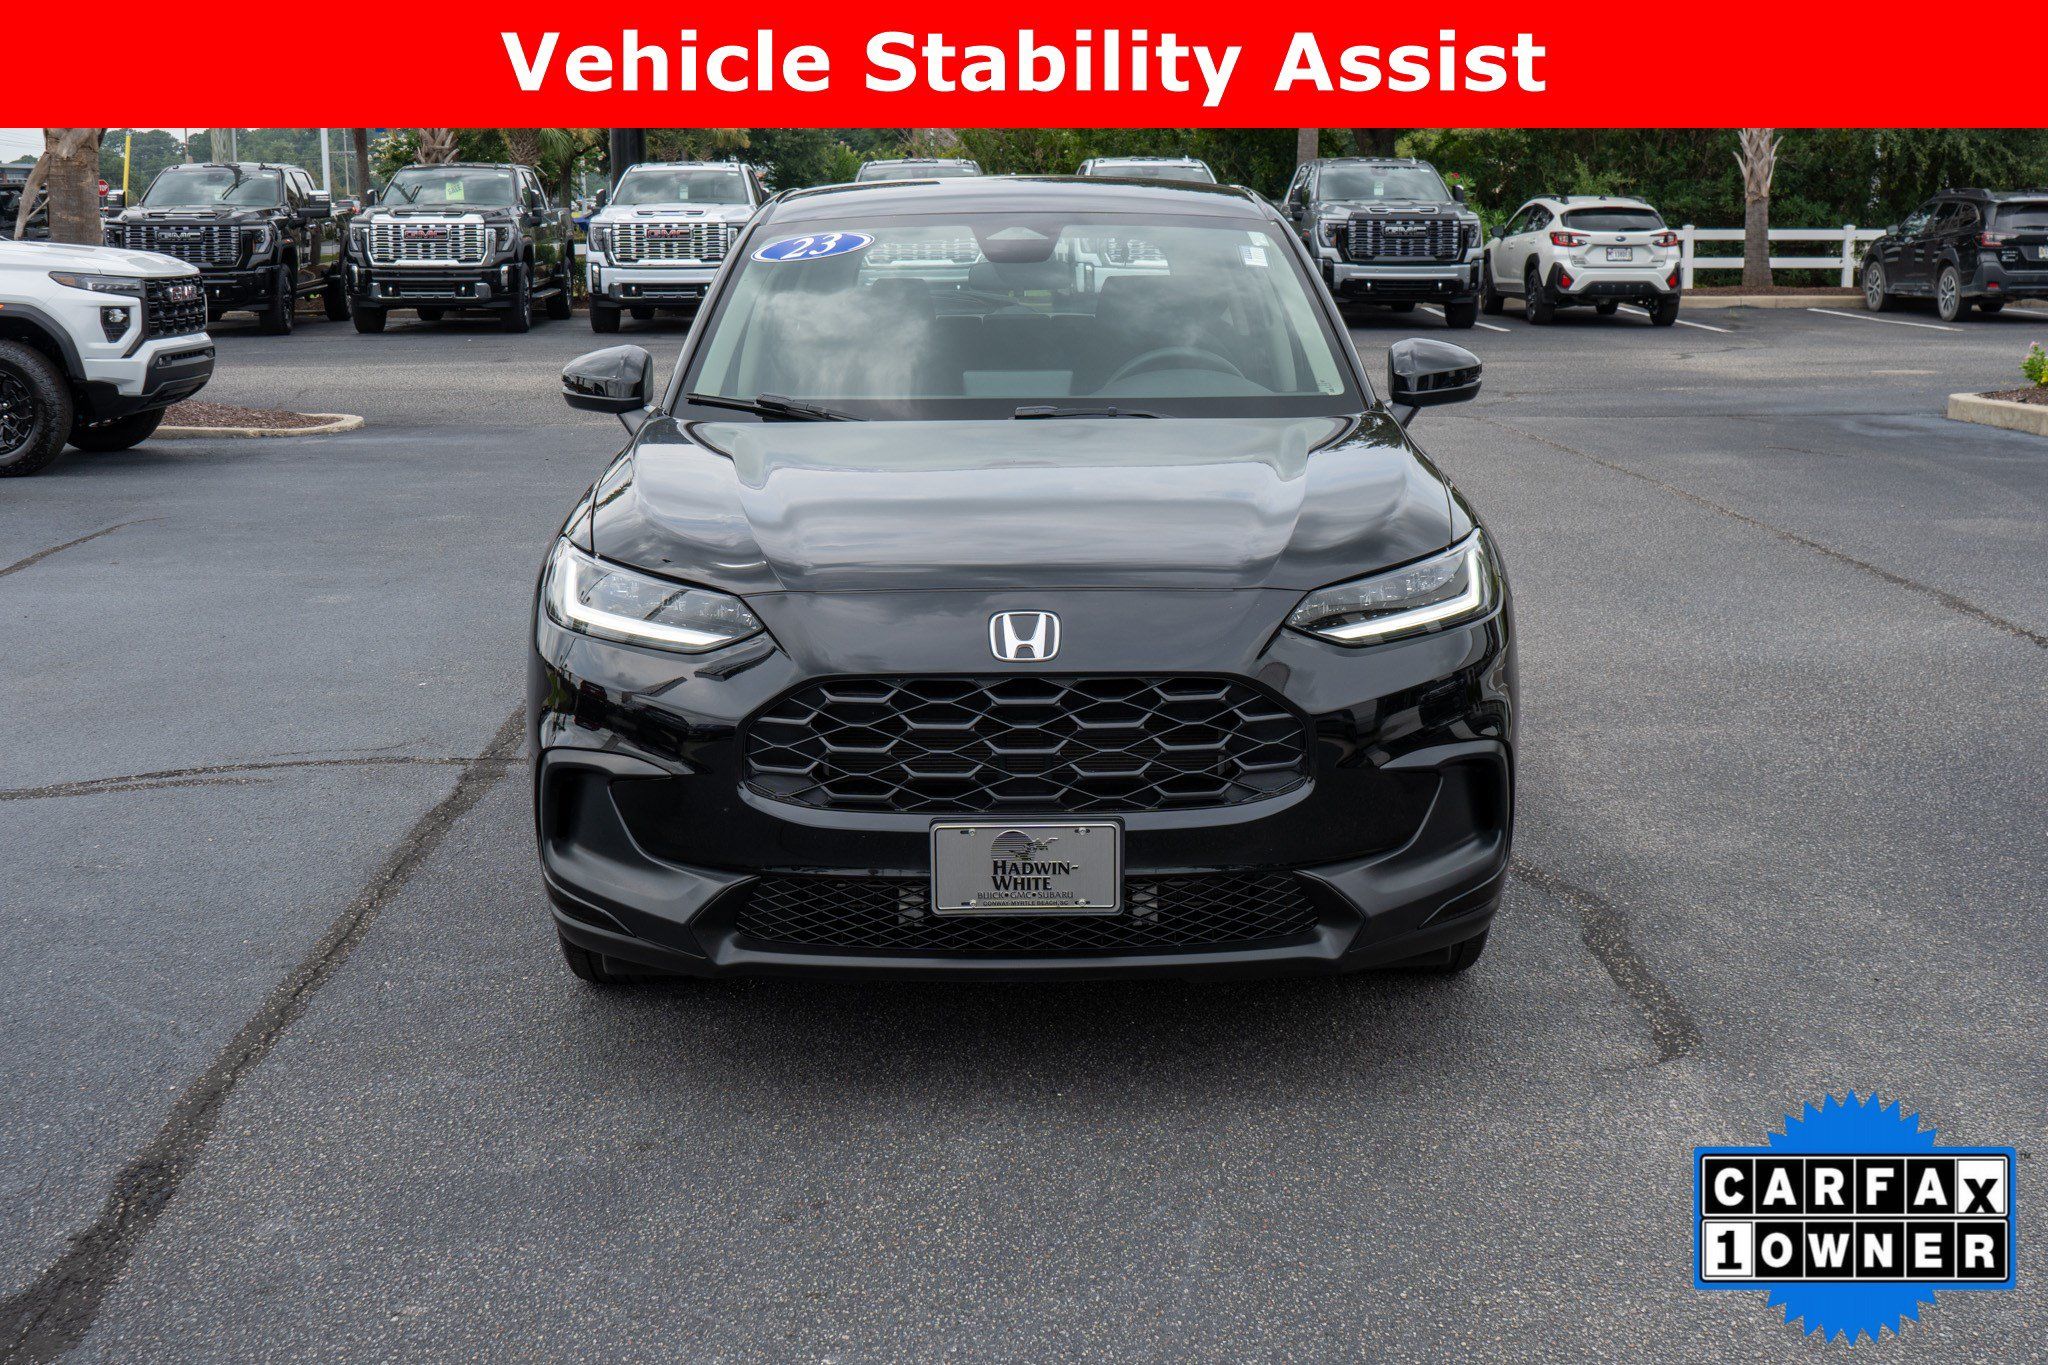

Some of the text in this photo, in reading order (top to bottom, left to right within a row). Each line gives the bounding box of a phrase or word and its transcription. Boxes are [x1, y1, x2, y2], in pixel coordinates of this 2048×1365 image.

[404, 230, 447, 239] GMC
[647, 229, 690, 238] GMC
[1385, 226, 1427, 236] GMC
[157, 232, 201, 241] GMC
[779, 232, 843, 260] 23
[992, 860, 1080, 875] HADWIN-
[991, 876, 1053, 891] WHITE
